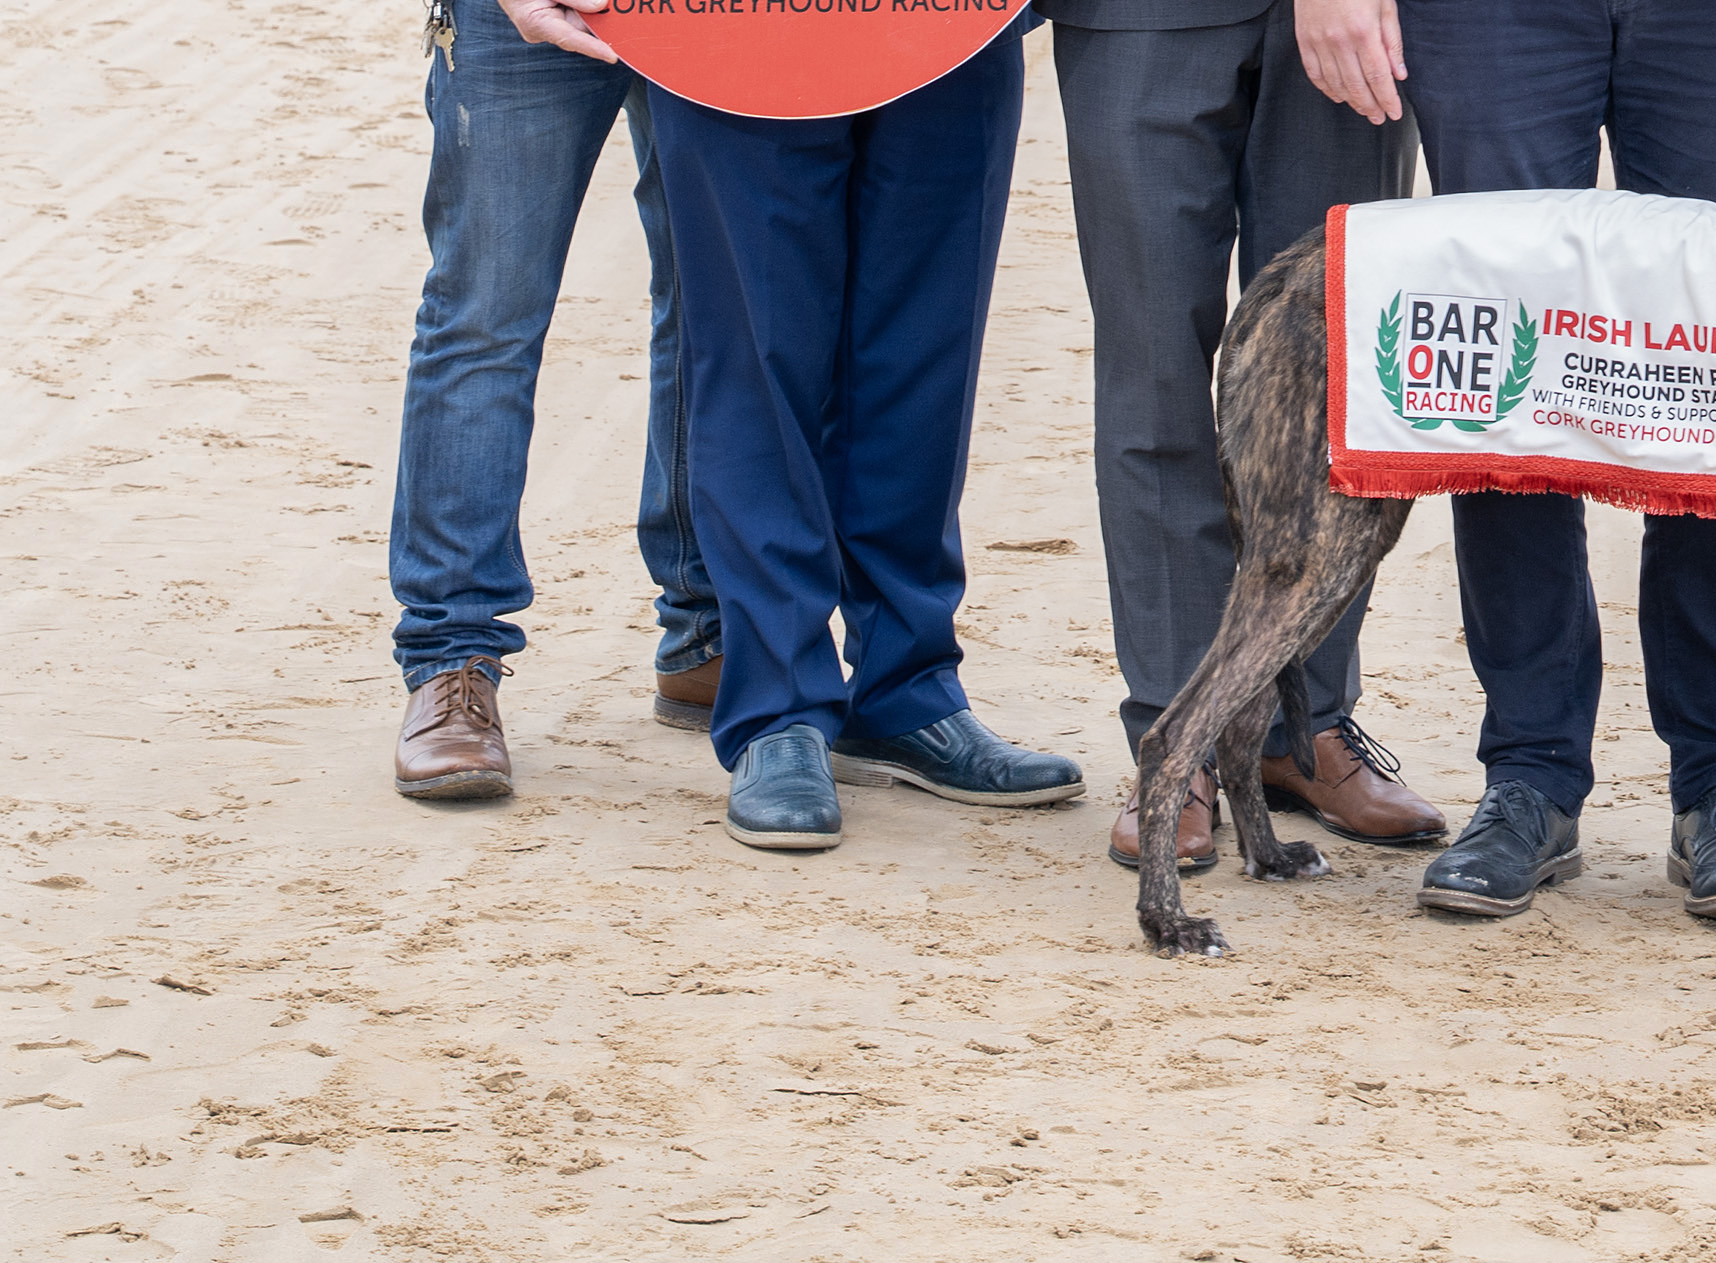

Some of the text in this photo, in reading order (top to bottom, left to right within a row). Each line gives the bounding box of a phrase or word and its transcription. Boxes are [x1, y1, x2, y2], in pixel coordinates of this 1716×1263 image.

[1411, 301, 1499, 345] BAR
[1543, 309, 1632, 347] IRISH
[1407, 344, 1494, 392] ONE
[1564, 352, 1704, 385] CURRAHEEN
[1406, 391, 1493, 414] RACING
[1532, 389, 1575, 407] WITH
[1578, 397, 1646, 418] FRIENDS
[1651, 405, 1662, 419] &
[1562, 374, 1685, 402] GREYHOUND
[1533, 409, 1586, 431] CORK
[1590, 420, 1715, 444] GREYHOUND
